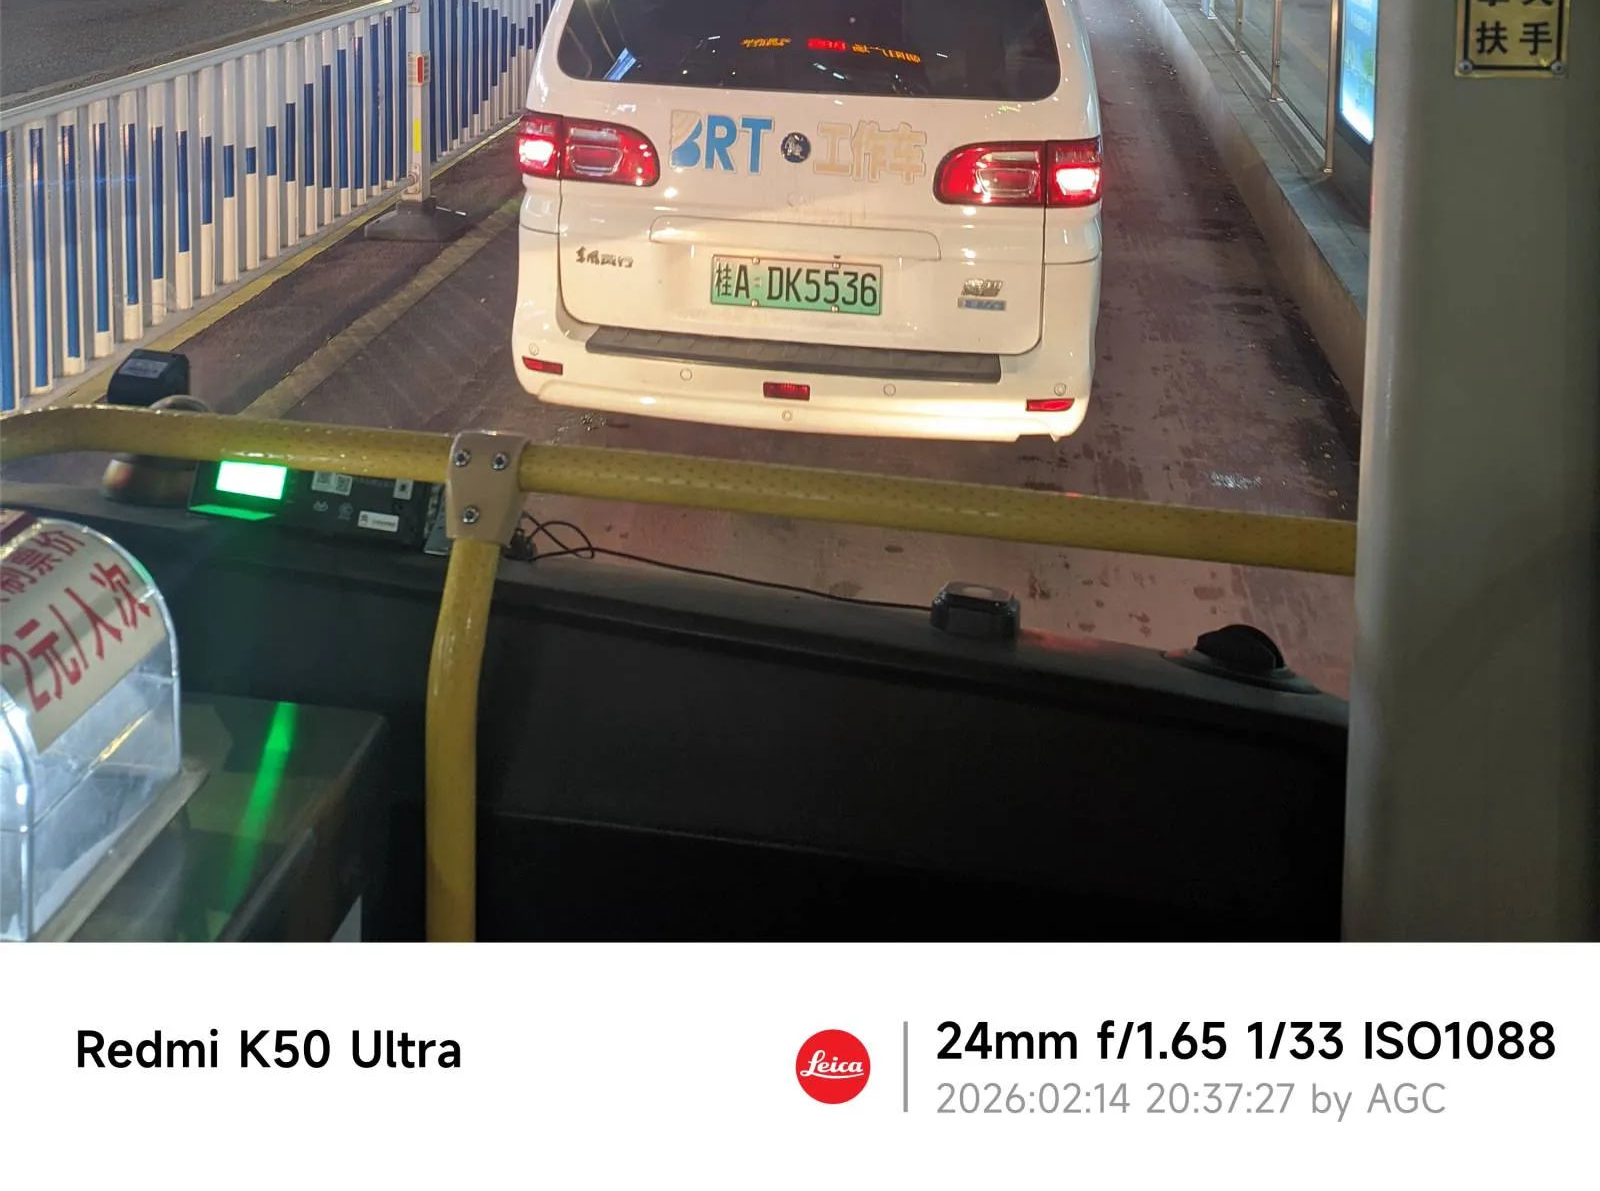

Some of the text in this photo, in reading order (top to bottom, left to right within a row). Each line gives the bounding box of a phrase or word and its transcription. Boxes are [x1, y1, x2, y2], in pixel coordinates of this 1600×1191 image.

[670, 111, 774, 176] BRT
[812, 119, 928, 185] 工作车
[715, 261, 878, 308] 桂A DK5536
